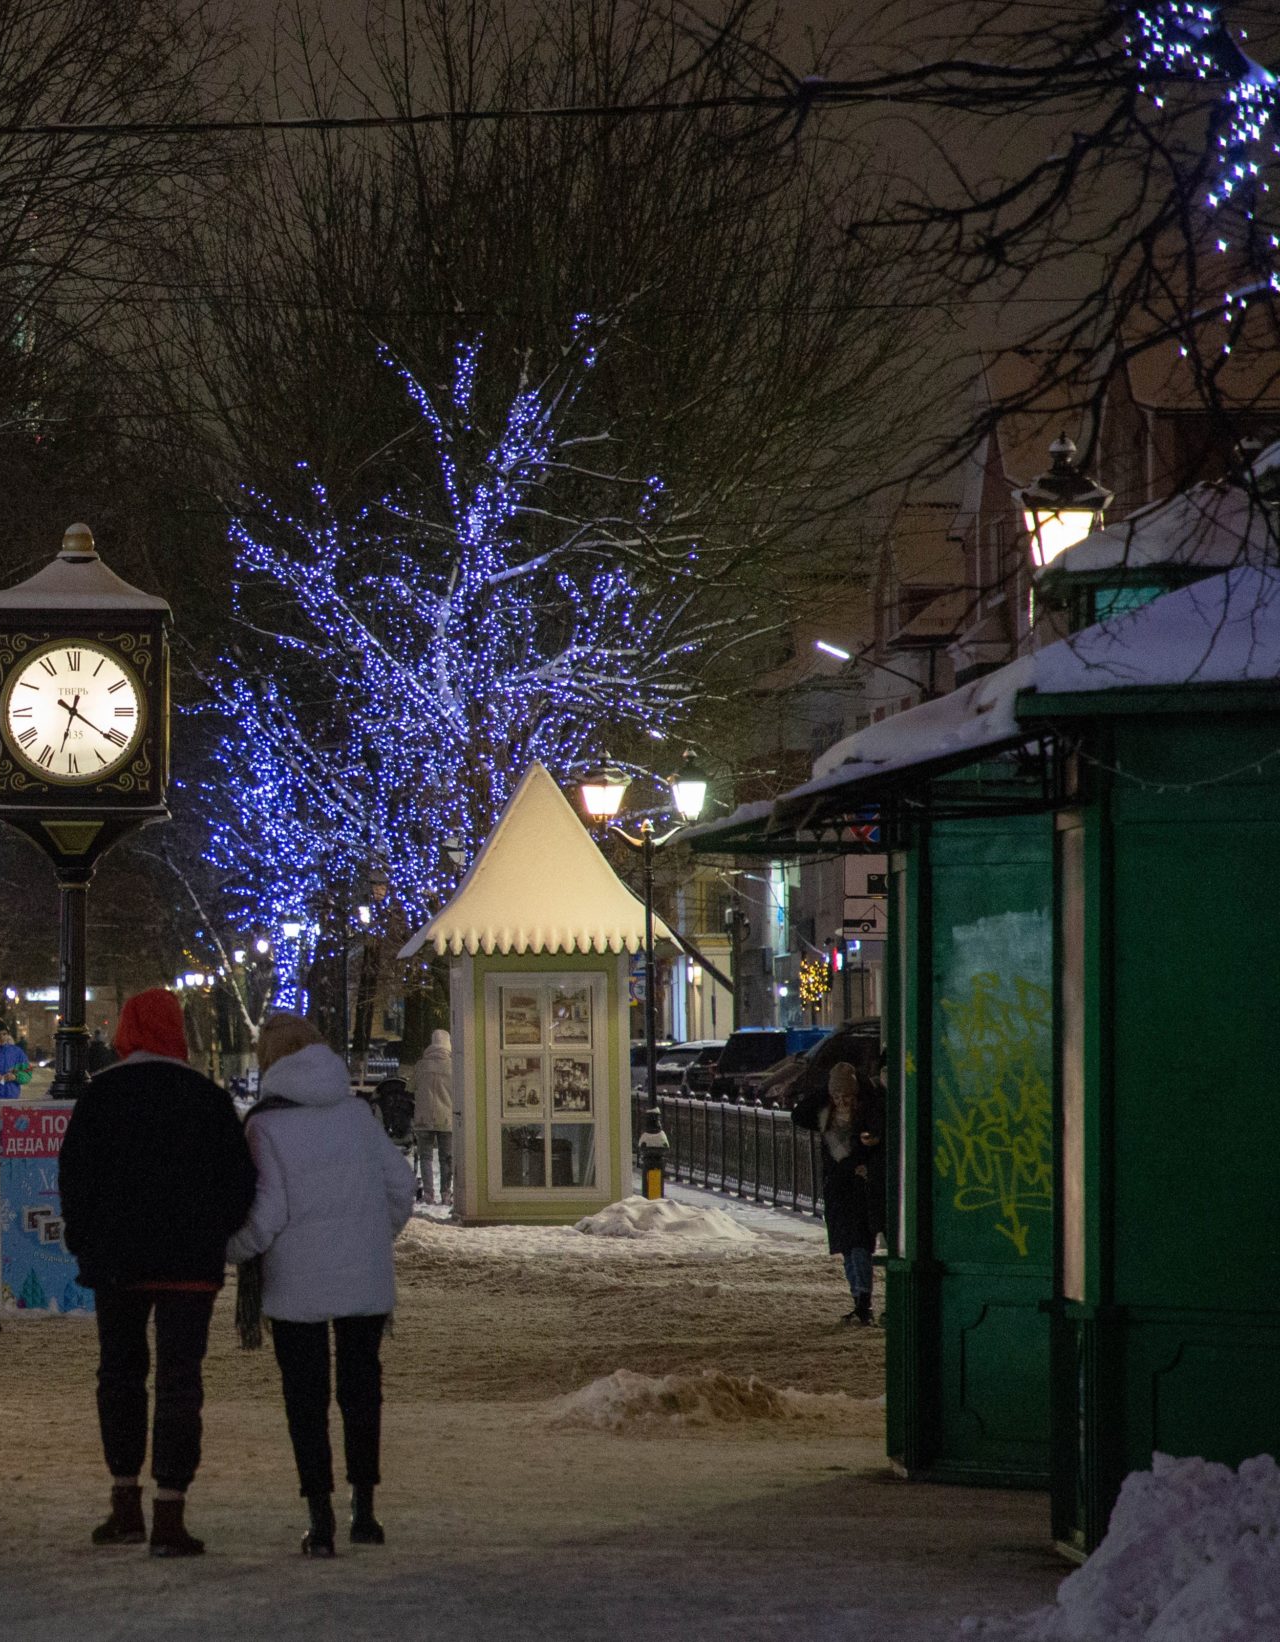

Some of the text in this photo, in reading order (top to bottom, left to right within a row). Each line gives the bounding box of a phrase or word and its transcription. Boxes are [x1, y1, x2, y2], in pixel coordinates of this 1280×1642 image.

[58, 688, 89, 696] ТВЕРЬ
[41, 1115, 72, 1134] ПО
[7, 1137, 44, 1156] ДЕДА
